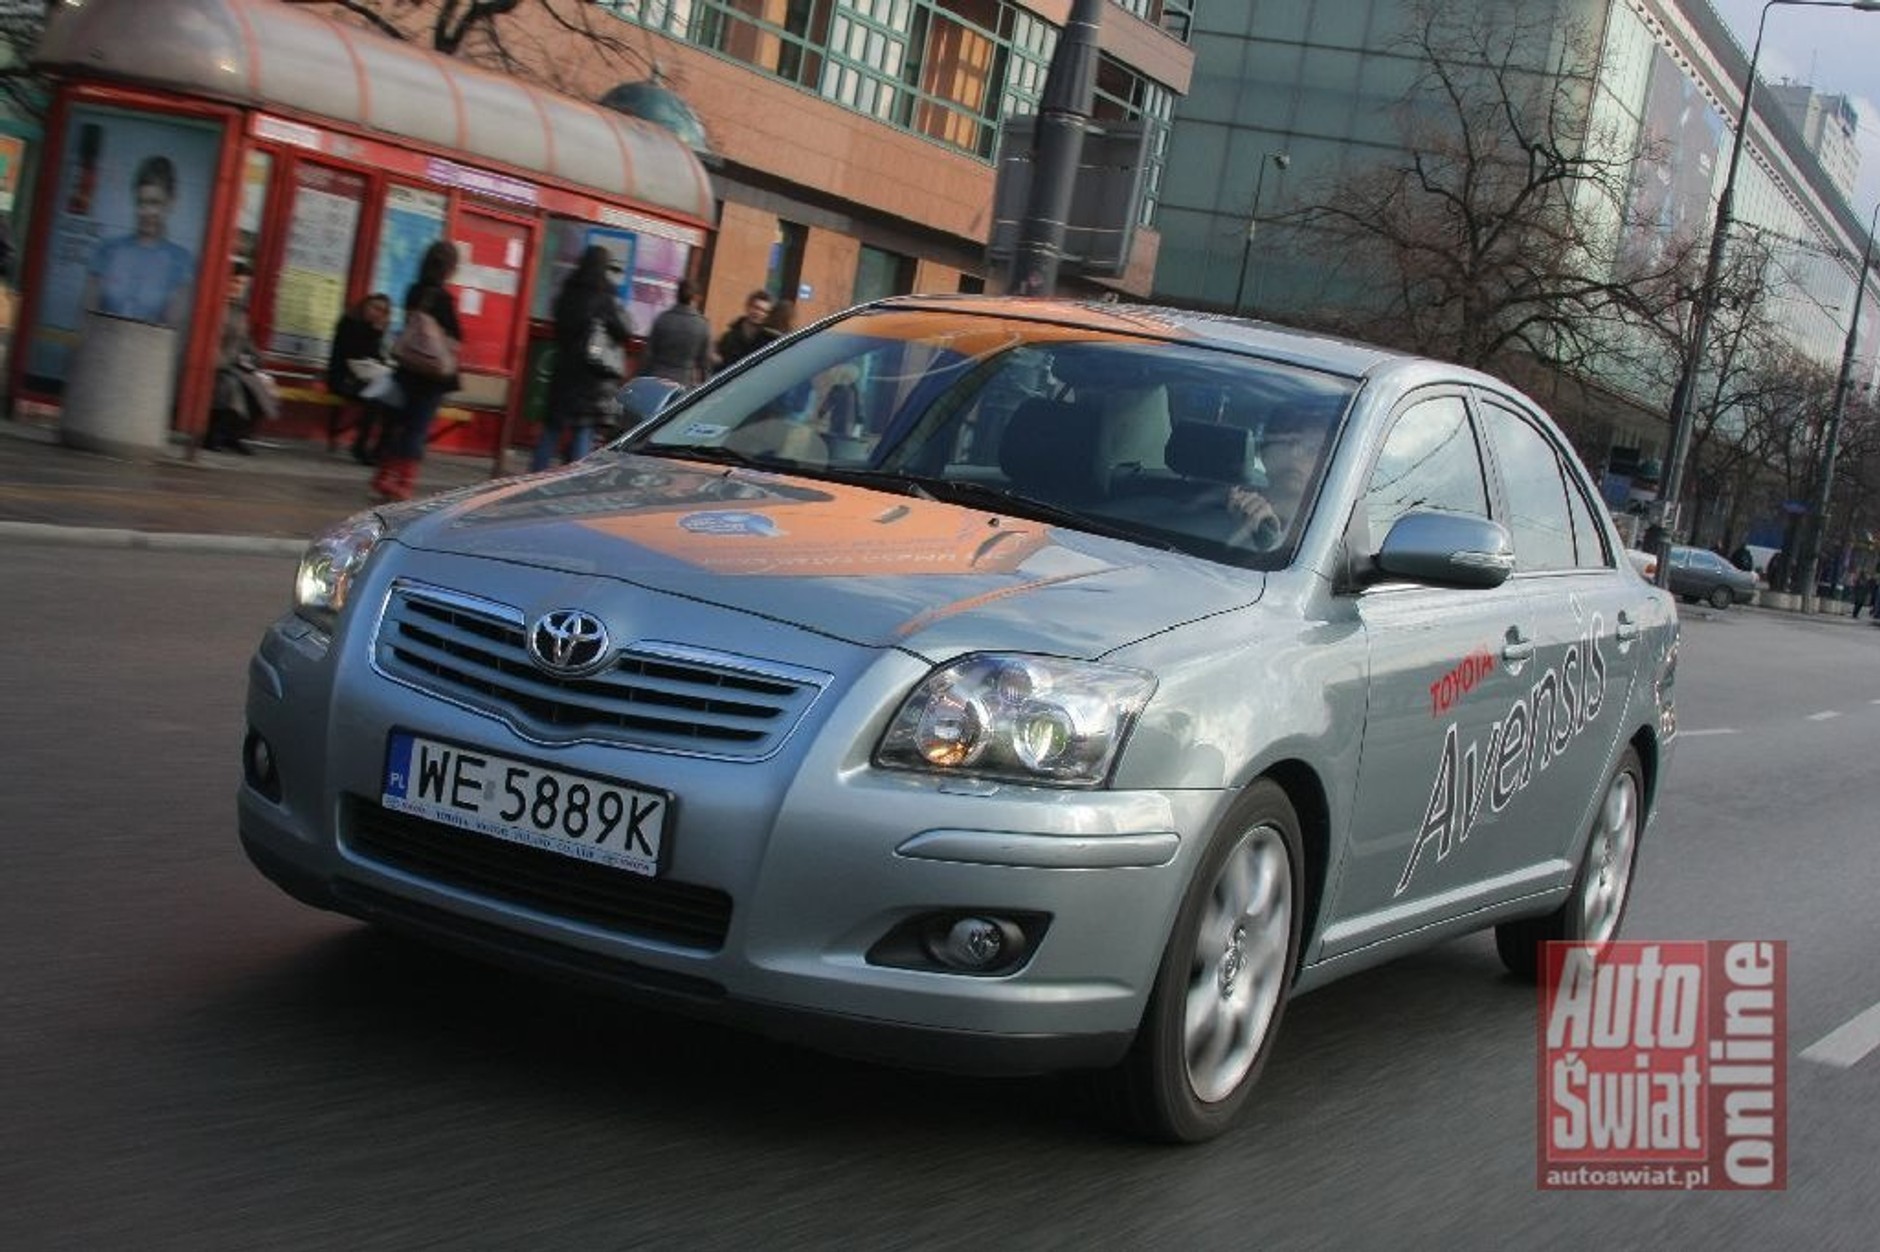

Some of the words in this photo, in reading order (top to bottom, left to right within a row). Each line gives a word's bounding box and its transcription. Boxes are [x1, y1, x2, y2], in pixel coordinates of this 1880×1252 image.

[1429, 651, 1494, 720] TOYOTA
[390, 772, 406, 789] PL
[1393, 591, 1606, 898] Avensis
[418, 745, 486, 812] WE
[499, 767, 660, 857] 5889K
